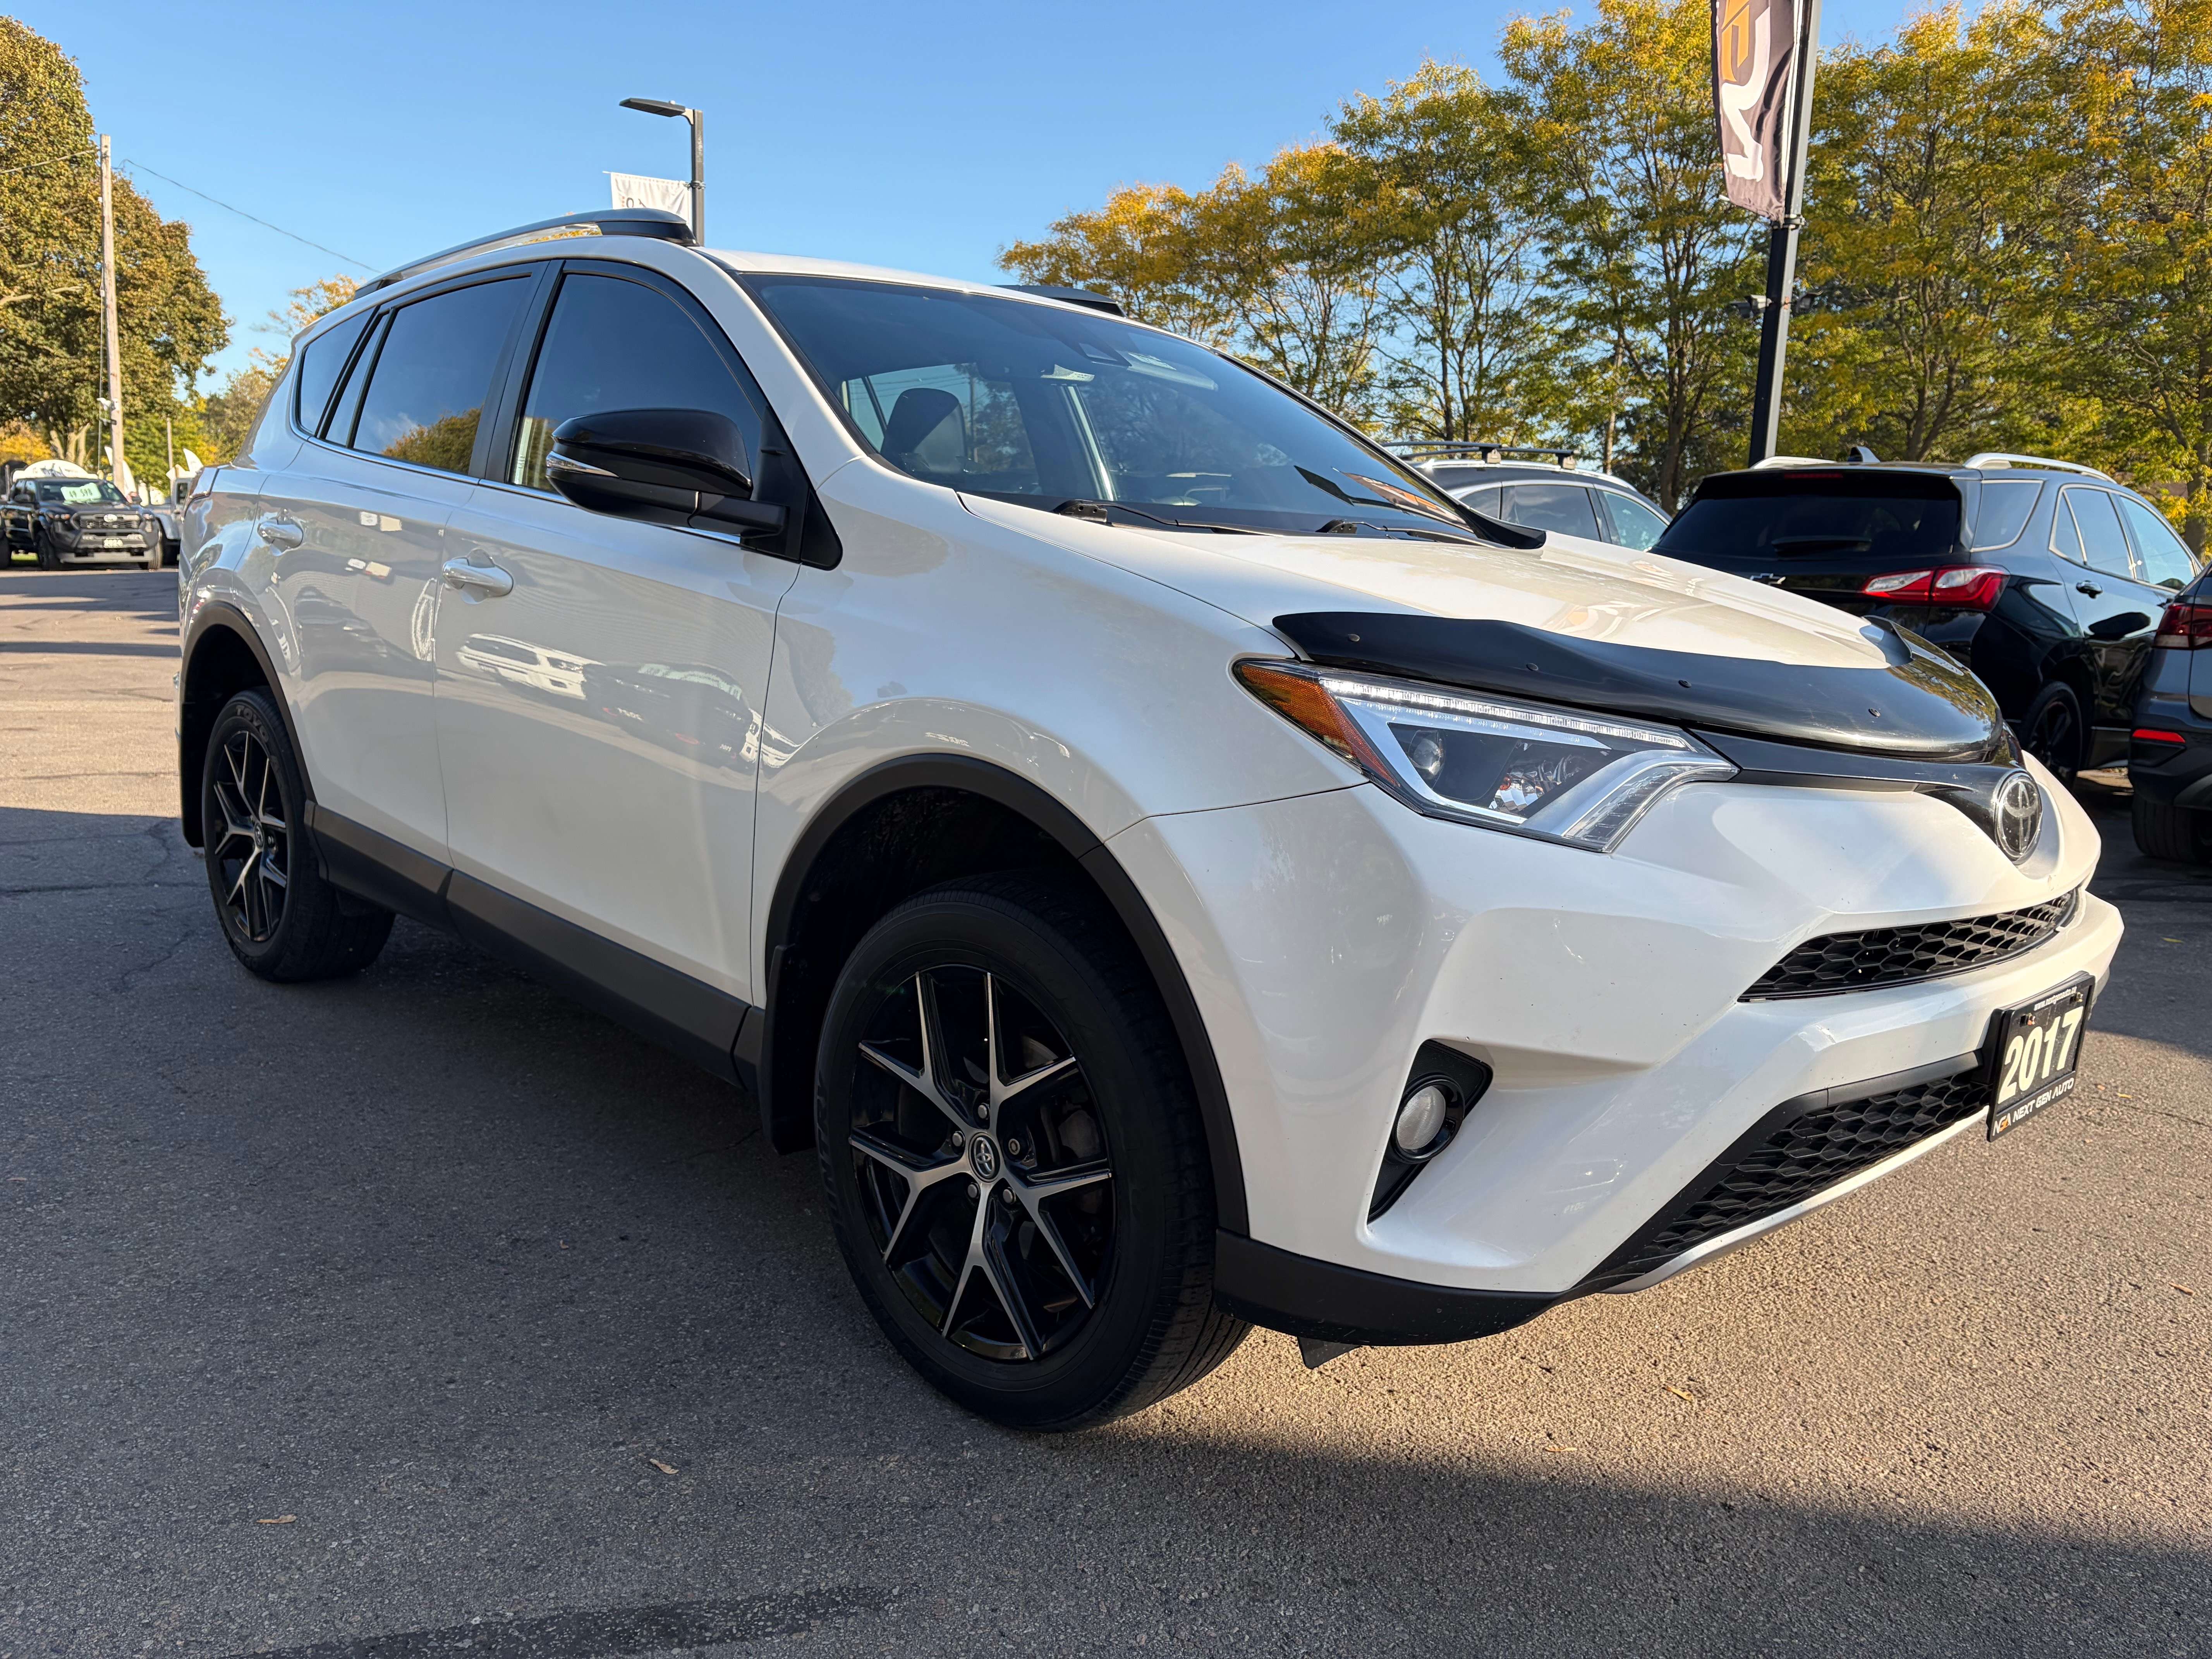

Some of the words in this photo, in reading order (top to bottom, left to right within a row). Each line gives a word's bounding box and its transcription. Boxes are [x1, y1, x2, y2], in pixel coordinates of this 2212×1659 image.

[236, 705, 269, 743] TOYO
[1998, 1006, 2084, 1104] 2017
[2013, 1099, 2035, 1122] NEXT
[2035, 1090, 2052, 1108] GEN
[2052, 1077, 2074, 1099] AUTO
